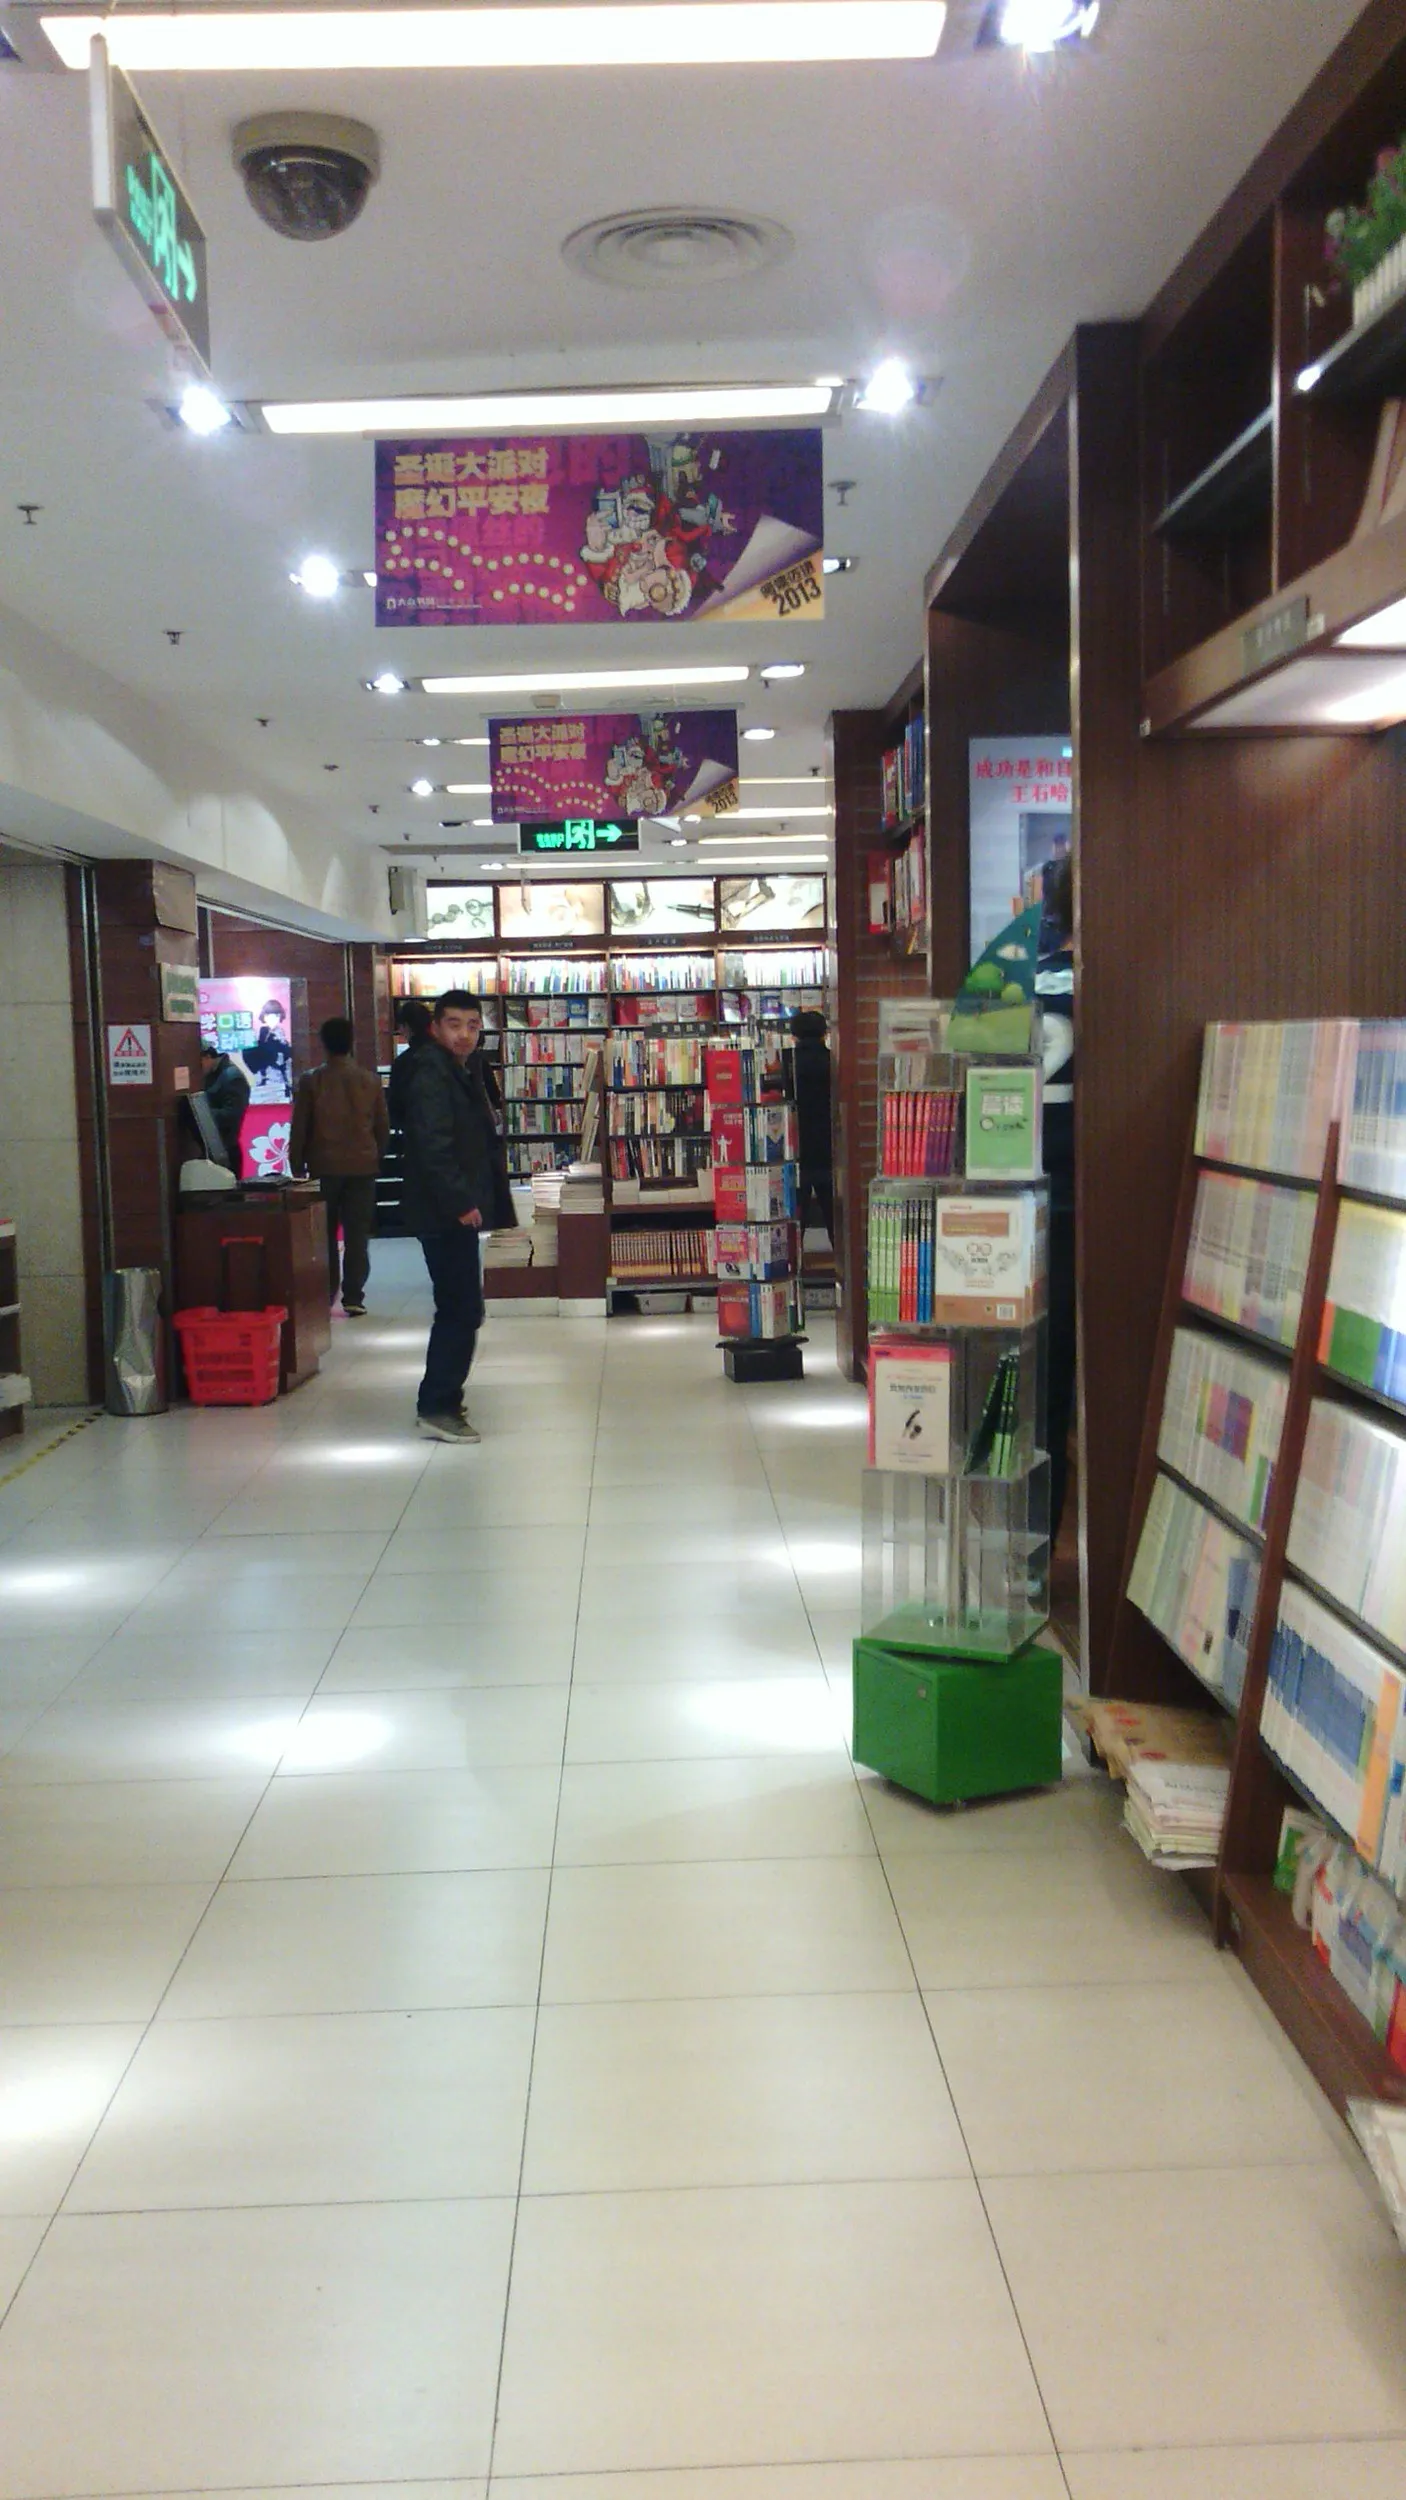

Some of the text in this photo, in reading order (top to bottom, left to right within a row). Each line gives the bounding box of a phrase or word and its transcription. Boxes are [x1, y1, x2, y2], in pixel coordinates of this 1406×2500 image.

[394, 447, 549, 485] 圣诞大派对
[394, 484, 550, 520] 魔幻平安夜
[772, 577, 821, 616] 2013
